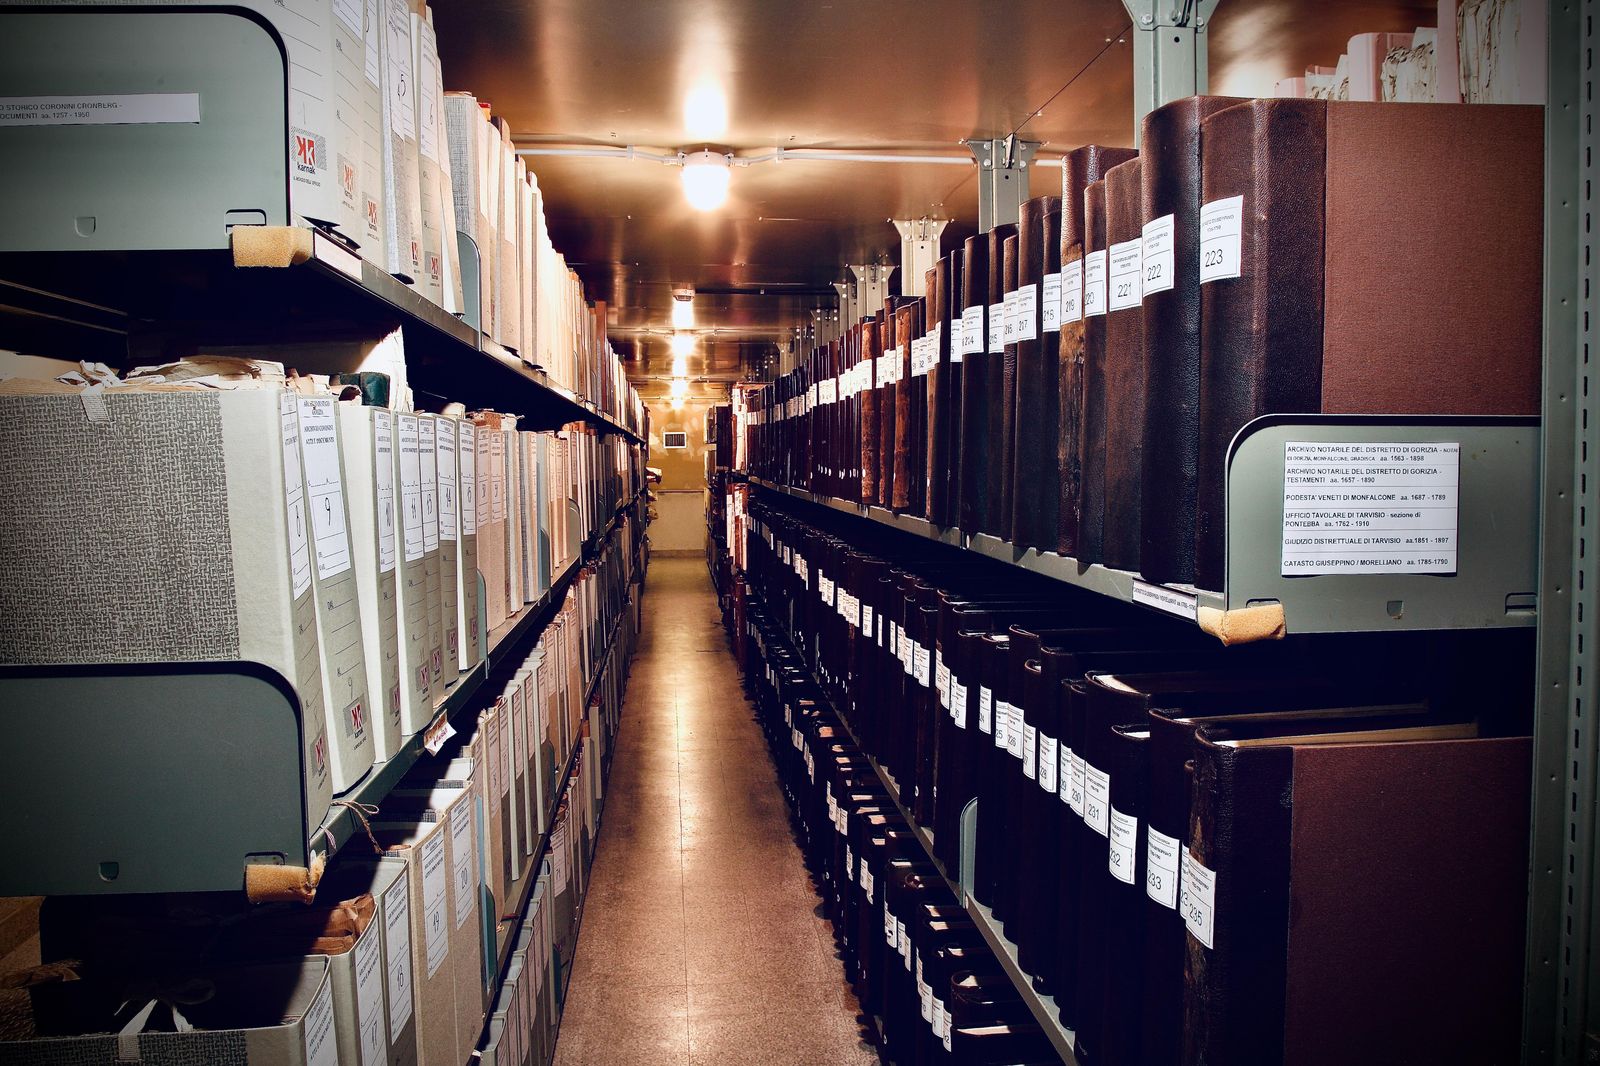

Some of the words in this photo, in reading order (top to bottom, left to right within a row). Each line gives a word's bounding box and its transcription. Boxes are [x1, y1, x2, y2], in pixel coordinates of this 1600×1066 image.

[1205, 249, 1223, 267] 223
[1147, 264, 1162, 282] 222
[1118, 282, 1131, 297] 221
[325, 497, 331, 526] 9
[1088, 804, 1099, 820] 231
[1190, 904, 1202, 926] 235
